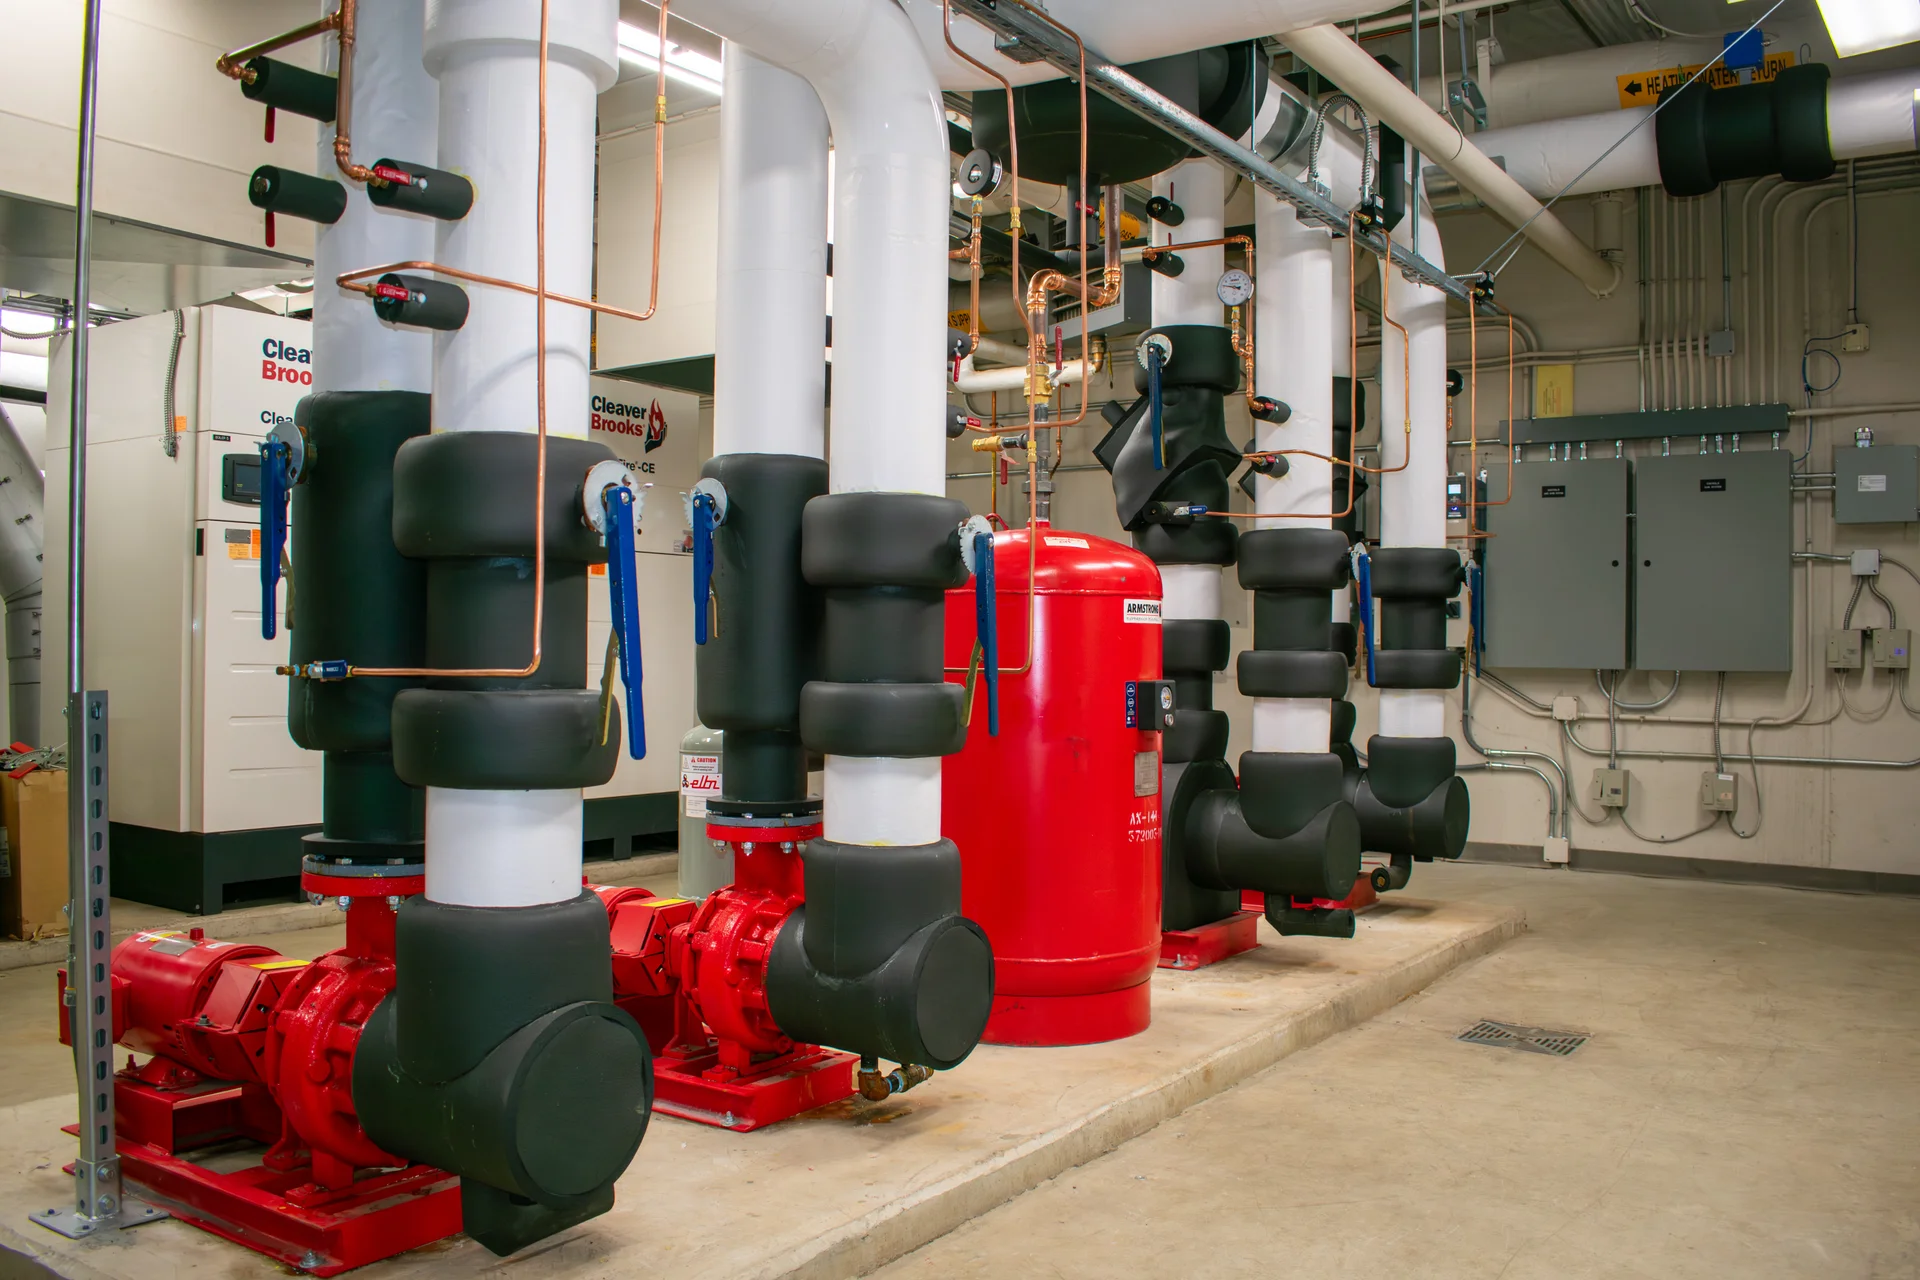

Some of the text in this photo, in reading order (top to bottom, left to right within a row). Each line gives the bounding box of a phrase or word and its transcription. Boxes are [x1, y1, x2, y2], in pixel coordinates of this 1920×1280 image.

[1751, 59, 1787, 82] ETURN
[262, 338, 313, 364] Clea
[262, 360, 312, 385] Broo
[591, 395, 647, 419] Cleaver
[591, 412, 643, 437] Brooks
[1127, 603, 1159, 614] ARMSTRONG
